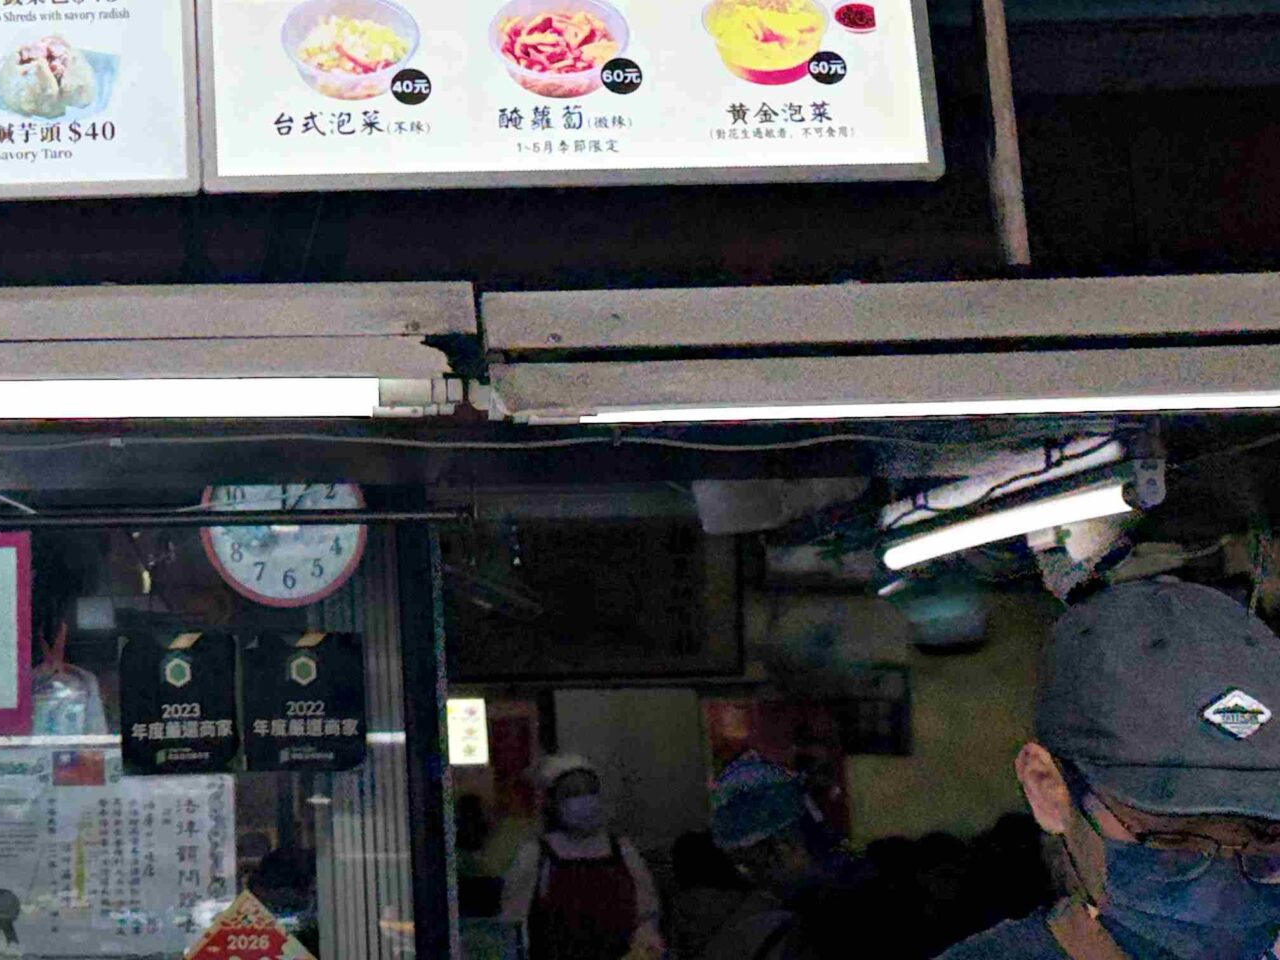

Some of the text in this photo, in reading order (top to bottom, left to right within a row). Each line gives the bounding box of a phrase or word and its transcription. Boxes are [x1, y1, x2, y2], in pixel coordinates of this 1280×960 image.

[3, 10, 37, 22] Shreds
[40, 10, 62, 21] with
[64, 10, 95, 23] savory
[98, 8, 130, 20] radish
[602, 69, 641, 83] 60元
[809, 60, 846, 75] 60元
[392, 80, 430, 93] 40元
[727, 101, 833, 125] 黃金泡菜
[68, 120, 115, 142] $40
[41, 148, 72, 159] Taro
[231, 542, 243, 562] 8
[330, 536, 342, 555] 4
[253, 561, 266, 581] 7
[311, 559, 324, 577] 5
[283, 569, 296, 589] 6
[161, 703, 201, 719] 2023
[286, 700, 325, 716] 2022
[226, 934, 270, 951] 2026
